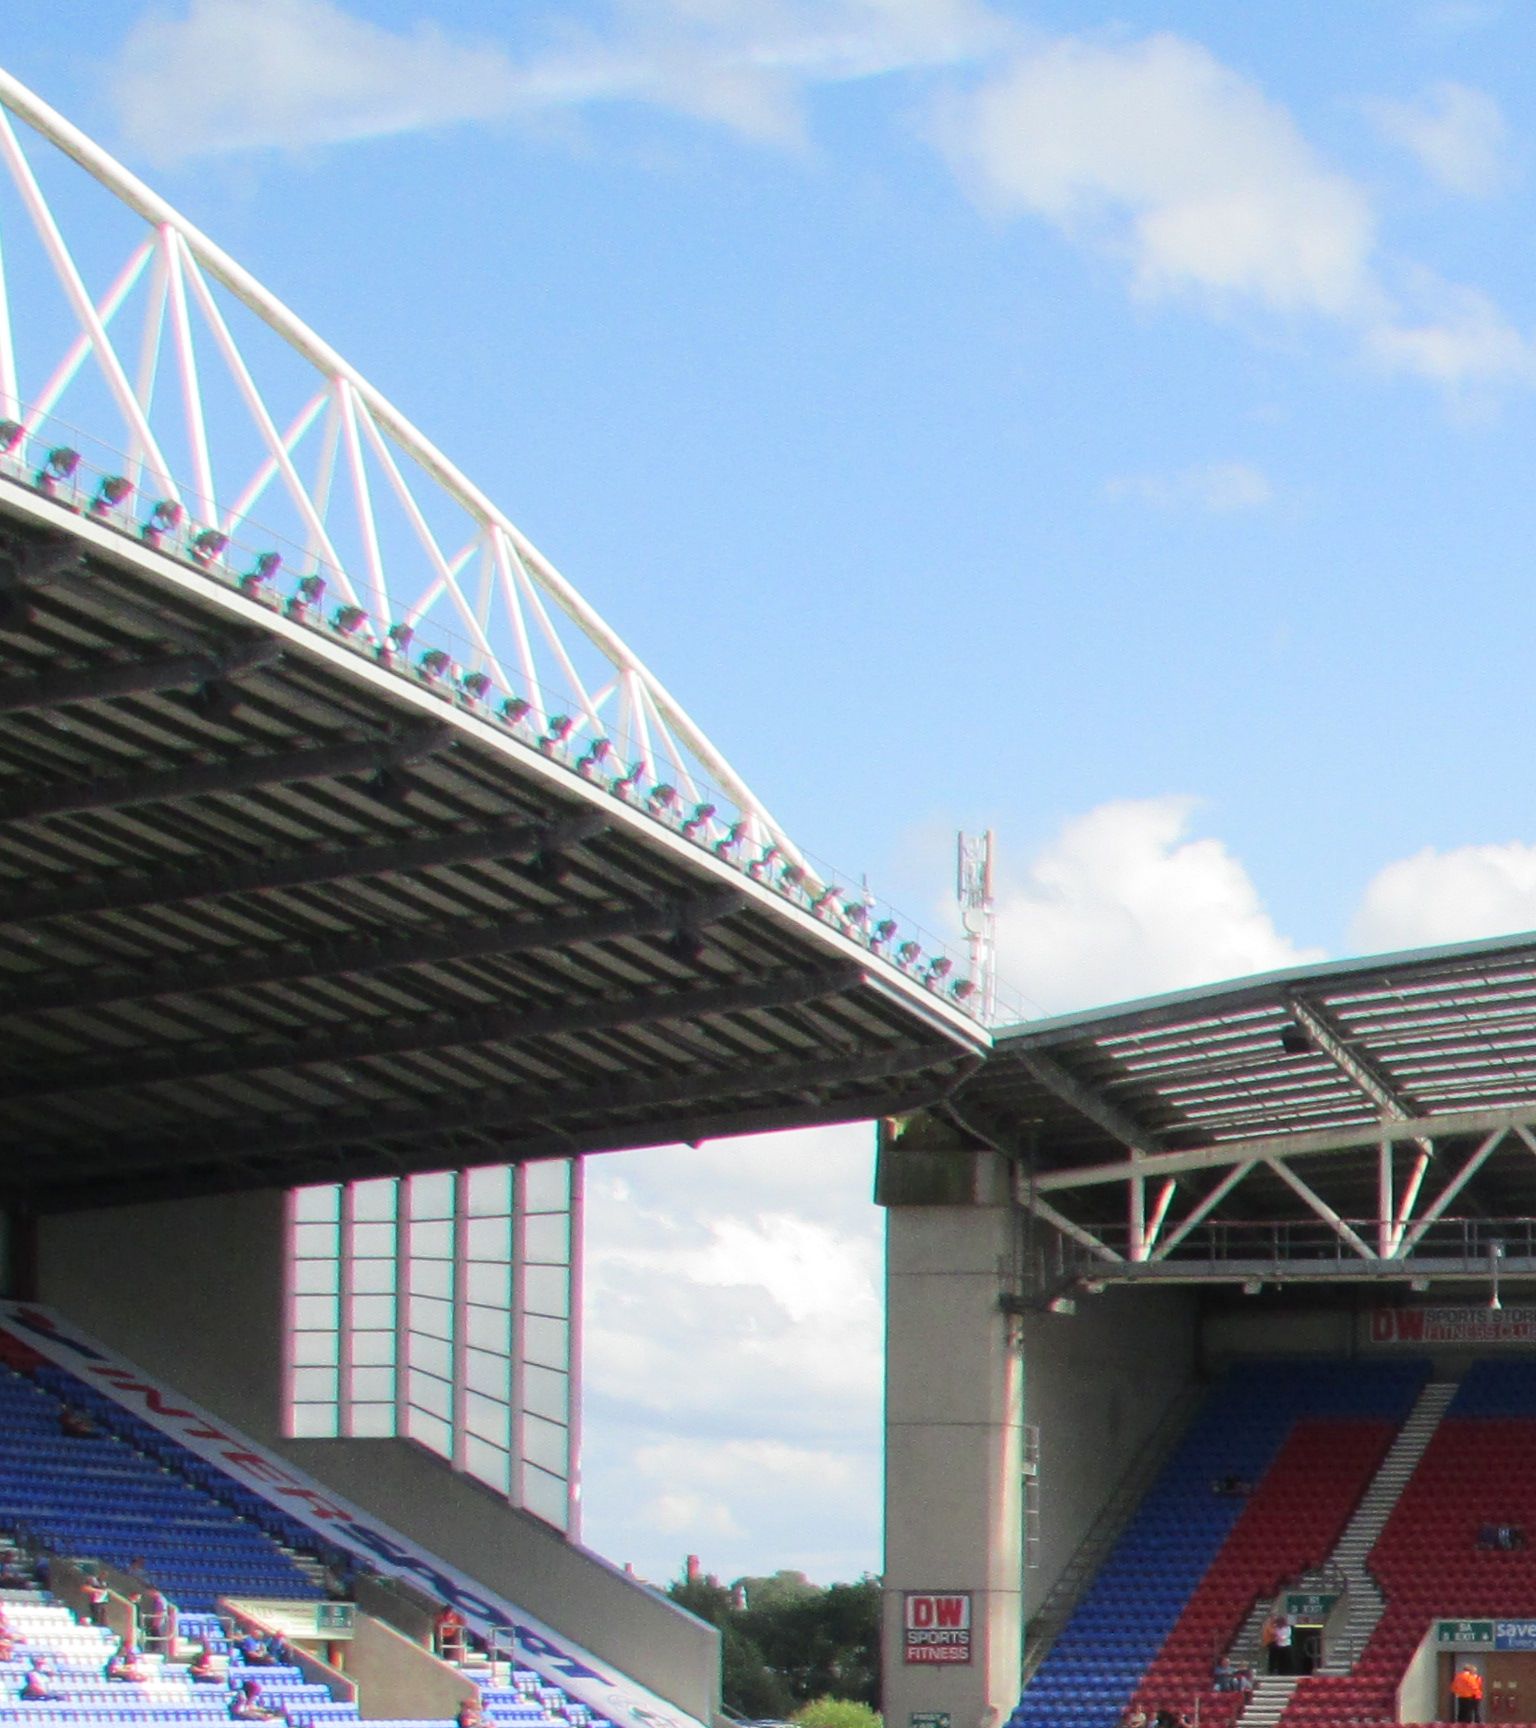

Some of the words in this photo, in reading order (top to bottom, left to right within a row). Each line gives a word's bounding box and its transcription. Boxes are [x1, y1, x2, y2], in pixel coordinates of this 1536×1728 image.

[1425, 1309, 1488, 1323] SPORTS
[1372, 1309, 1425, 1341] DW
[914, 1598, 963, 1629] DW
[907, 1632, 970, 1645] SPORTS
[1455, 1632, 1475, 1641] EXIT
[907, 1646, 970, 1660] FITNESS
